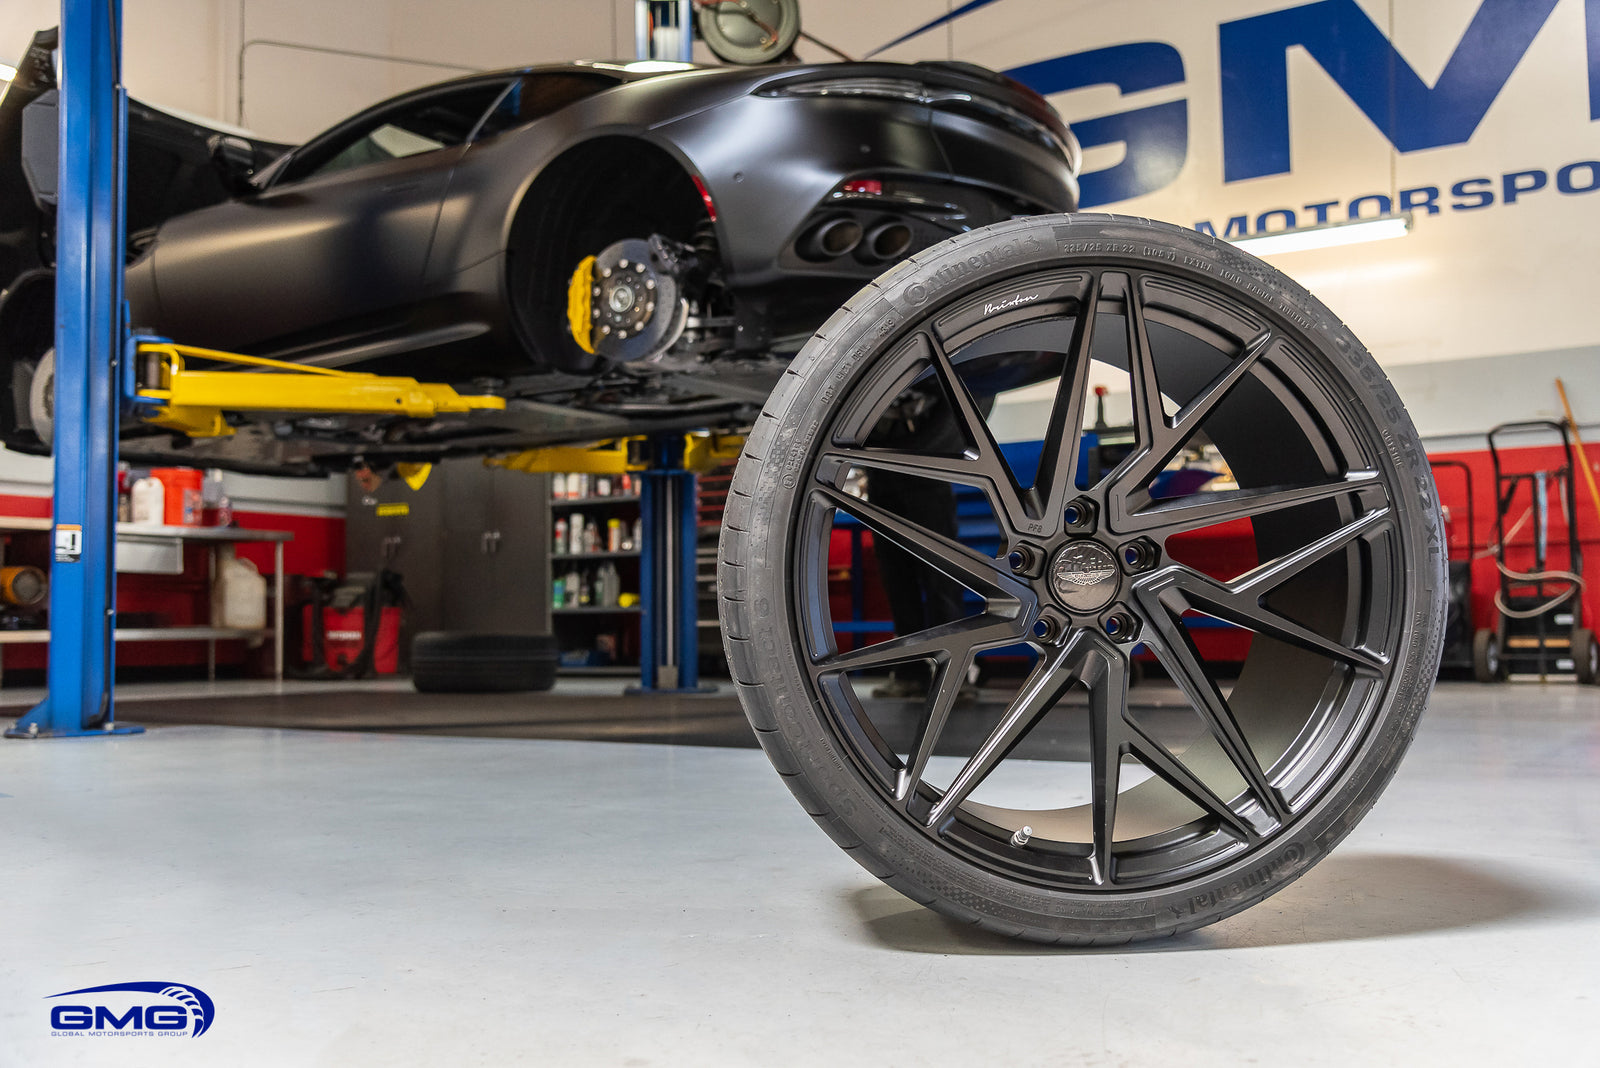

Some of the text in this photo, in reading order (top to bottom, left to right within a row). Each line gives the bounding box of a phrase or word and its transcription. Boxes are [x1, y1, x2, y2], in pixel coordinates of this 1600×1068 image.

[903, 238, 1026, 307] Continental
[1335, 336, 1440, 562] 335/25 ZR 22 XL
[1186, 841, 1307, 915] Continental
